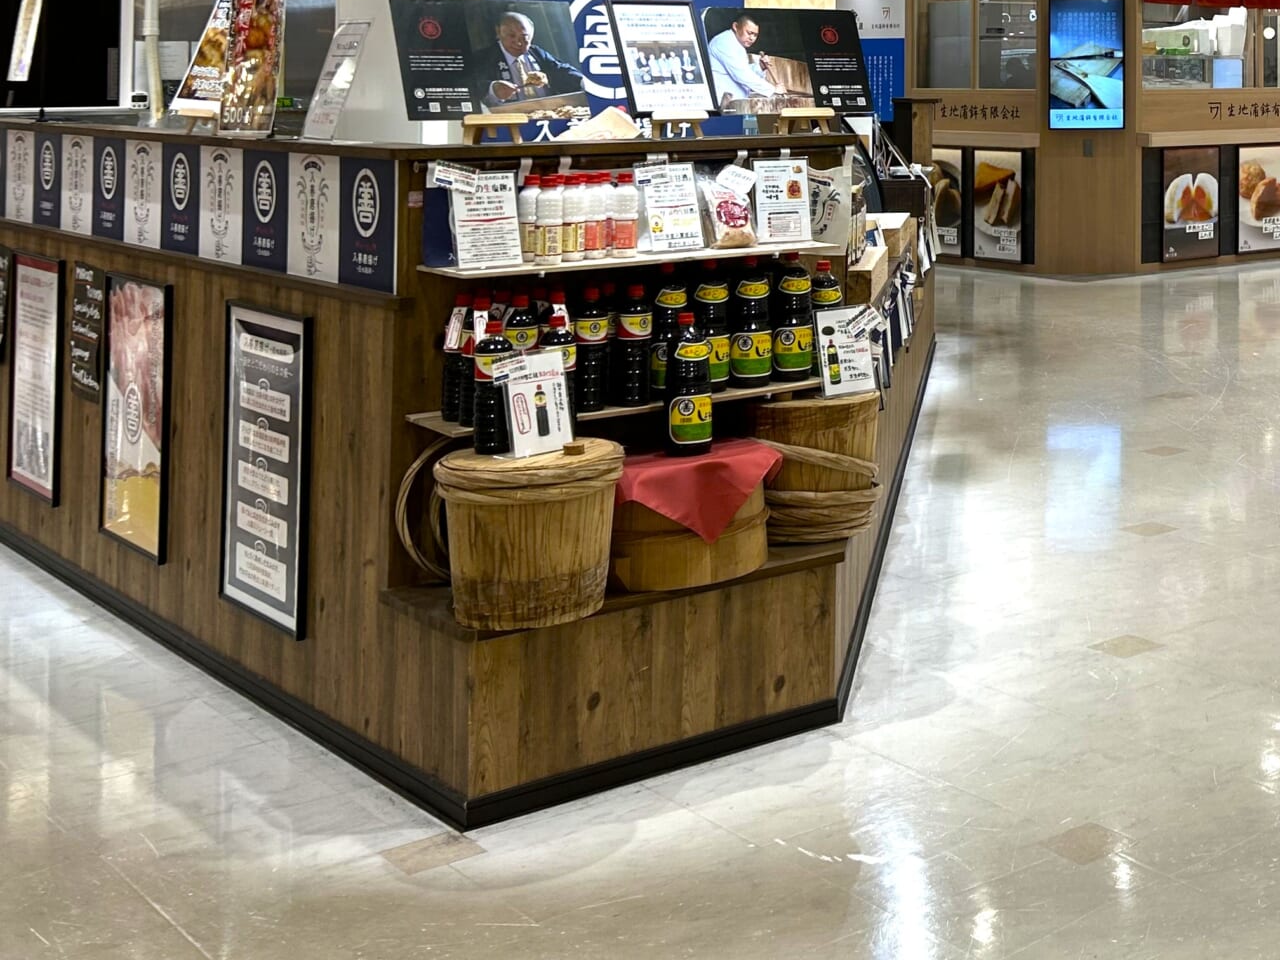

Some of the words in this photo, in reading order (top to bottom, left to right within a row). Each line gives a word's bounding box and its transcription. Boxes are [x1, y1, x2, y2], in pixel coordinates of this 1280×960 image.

[940, 103, 1021, 121] 生地蒲鉾有限会社
